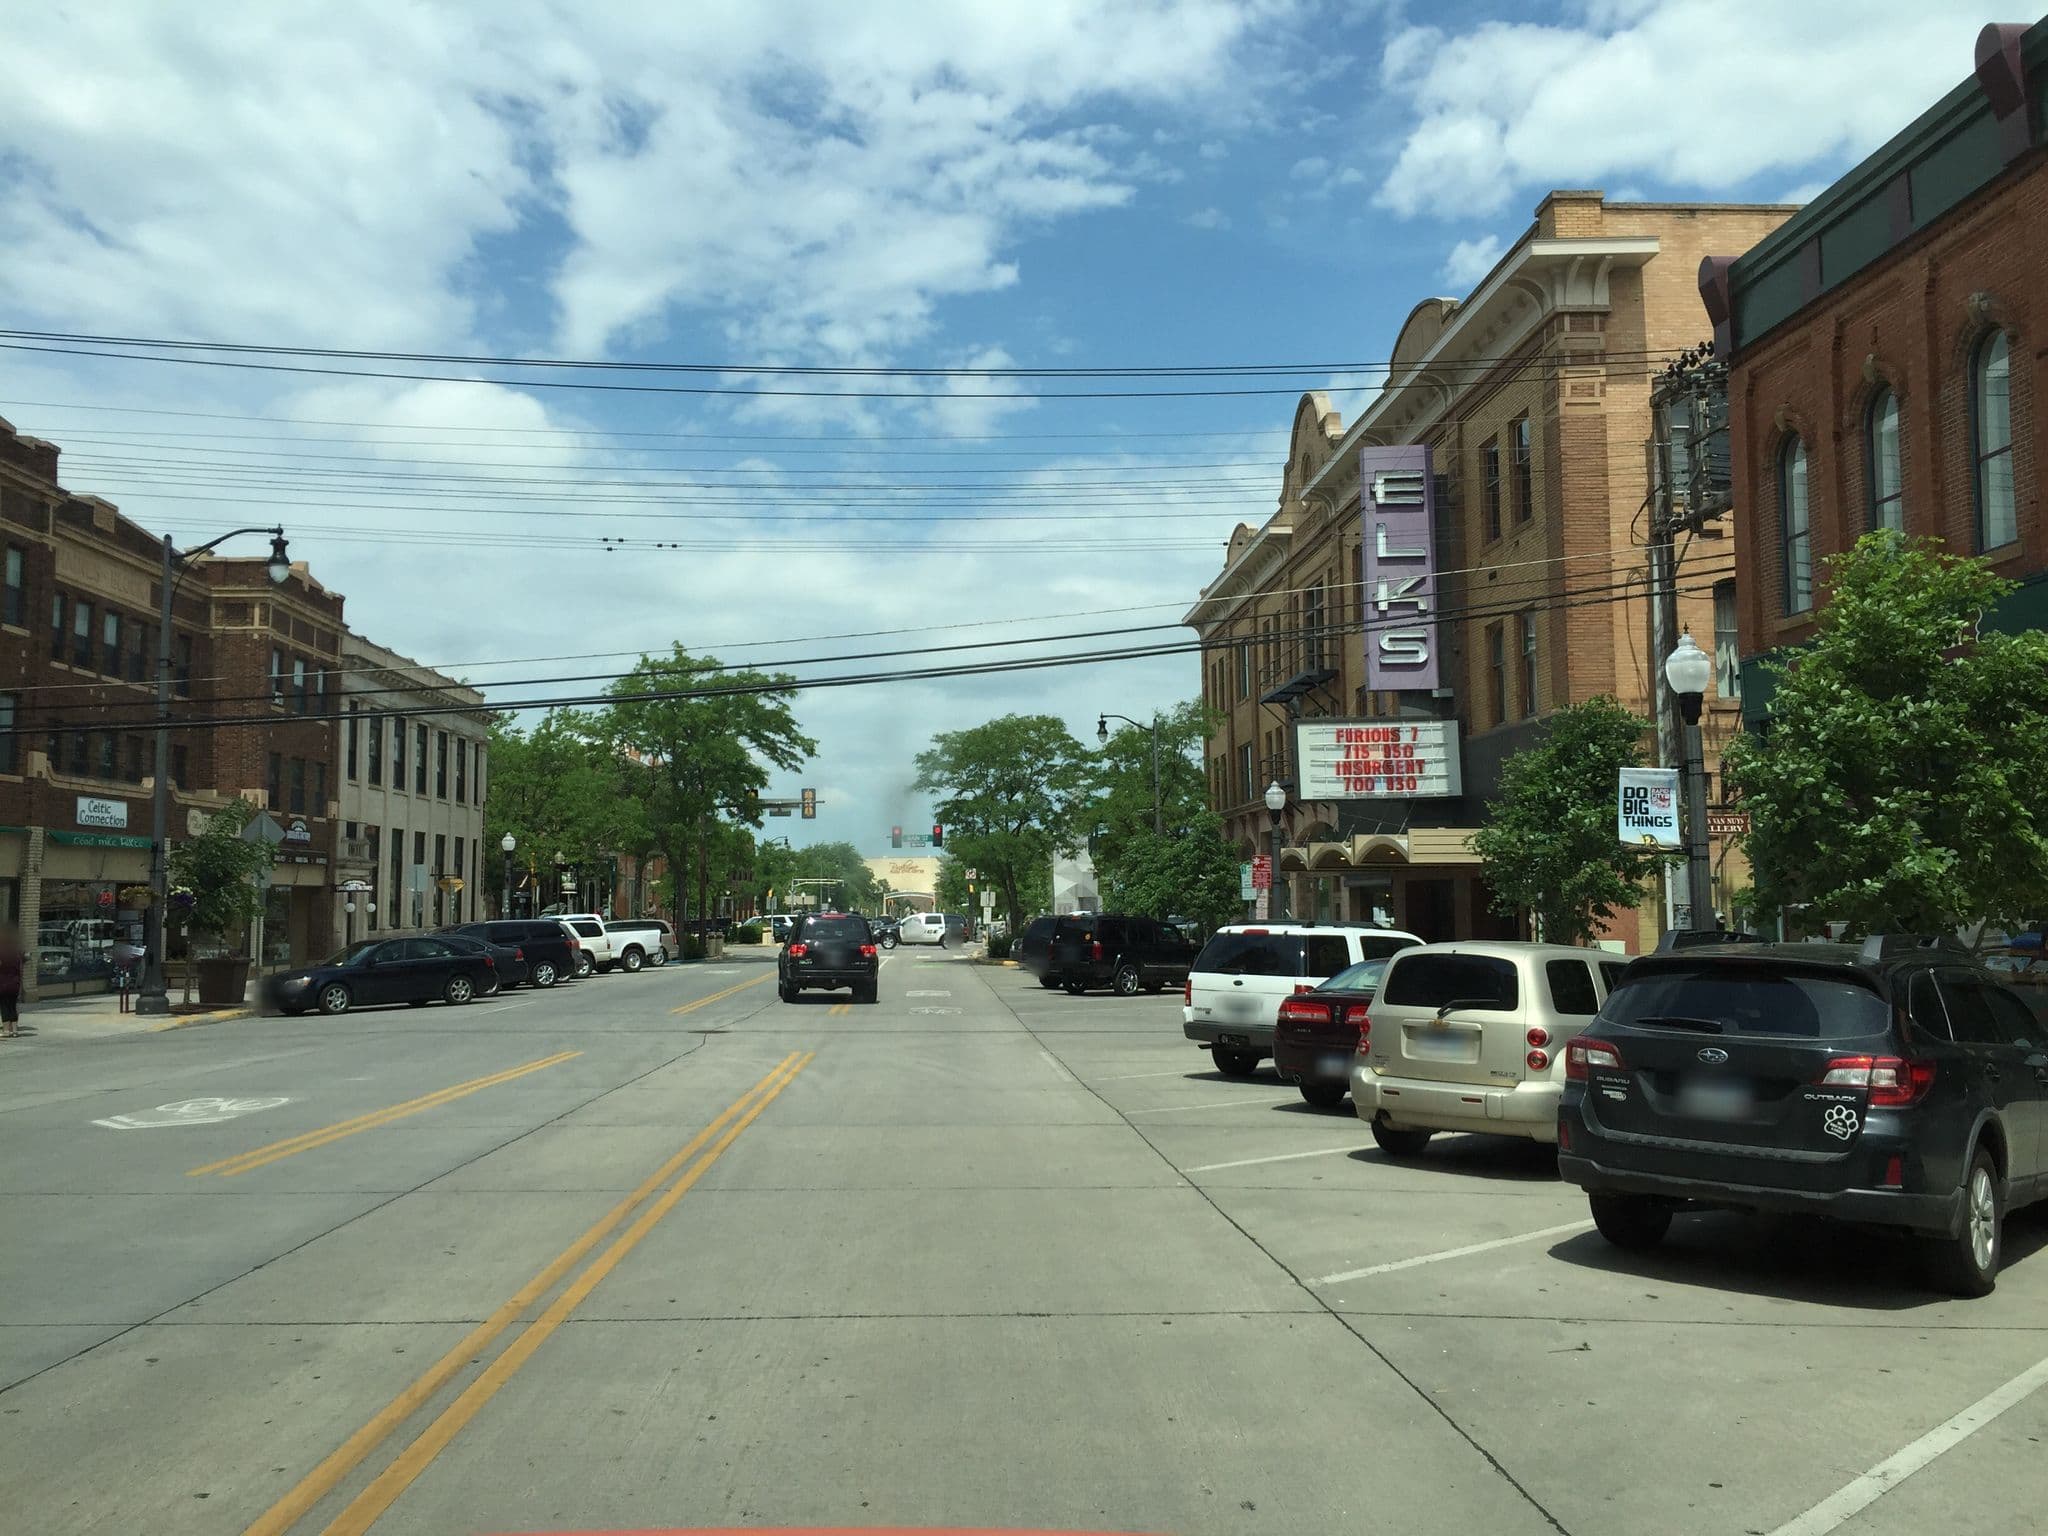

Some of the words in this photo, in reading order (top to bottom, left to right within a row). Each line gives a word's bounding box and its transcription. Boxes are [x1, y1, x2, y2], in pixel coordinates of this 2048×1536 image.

[1372, 470, 1429, 664] ELKS
[1335, 727, 1400, 743] FURIOUS
[1411, 726, 1418, 741] 7
[1344, 745, 1369, 759] 715
[1335, 759, 1425, 775] INSURGENT
[1344, 777, 1375, 791] 700
[1624, 786, 1648, 799] DO
[88, 800, 112, 814] Celtic
[1623, 799, 1649, 815] BIG
[80, 810, 125, 826] Connection
[1623, 815, 1673, 827] THINGS
[1803, 1093, 1857, 1102] OUTBACK
